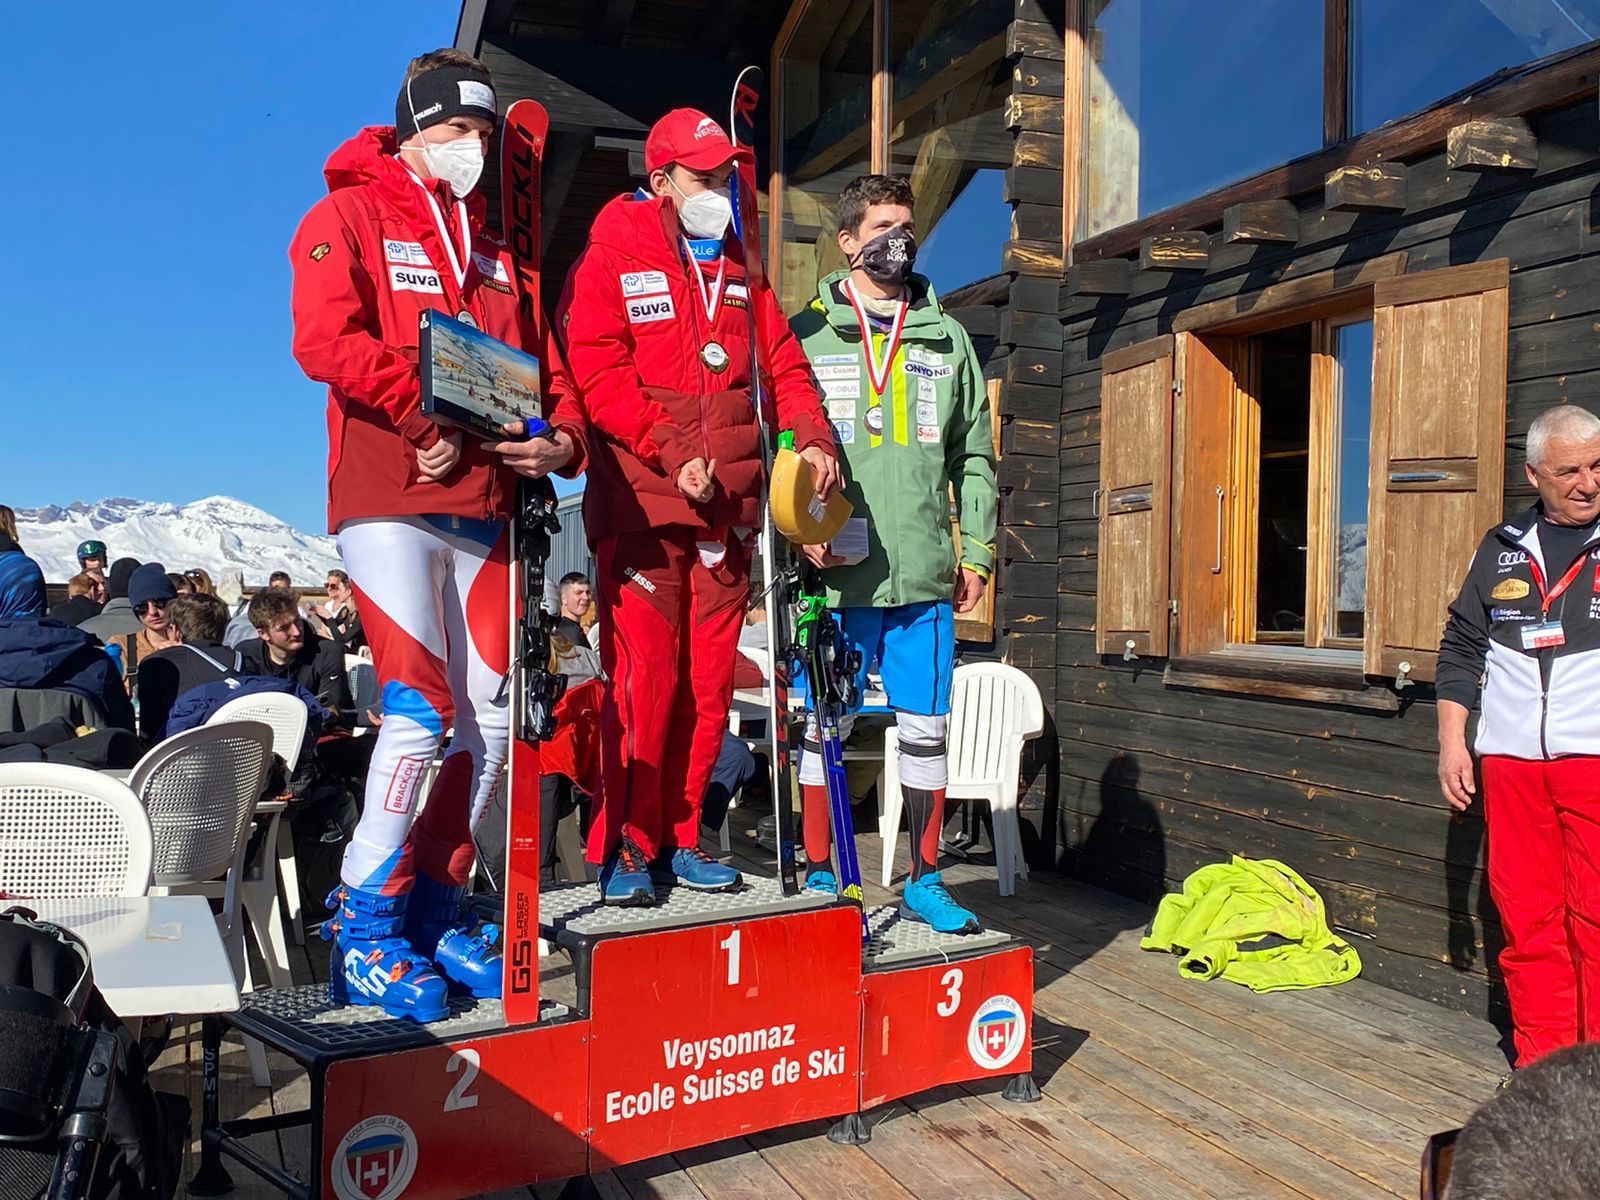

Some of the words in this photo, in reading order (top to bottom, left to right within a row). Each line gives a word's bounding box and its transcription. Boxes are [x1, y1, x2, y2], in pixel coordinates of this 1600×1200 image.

[395, 271, 439, 287] suva
[631, 302, 671, 317] suva
[904, 363, 951, 377] ONYONE
[624, 566, 657, 594] SUISSE
[516, 892, 524, 938] LASER
[512, 940, 531, 994] GS
[720, 929, 741, 986] 1
[936, 968, 964, 1017] 3
[663, 1023, 796, 1070] Veysonnaz
[443, 1048, 481, 1113] 2
[605, 1082, 675, 1124] Ecole
[682, 1069, 764, 1106] Suisse
[771, 1056, 801, 1086] de
[807, 1046, 846, 1079] Ski
